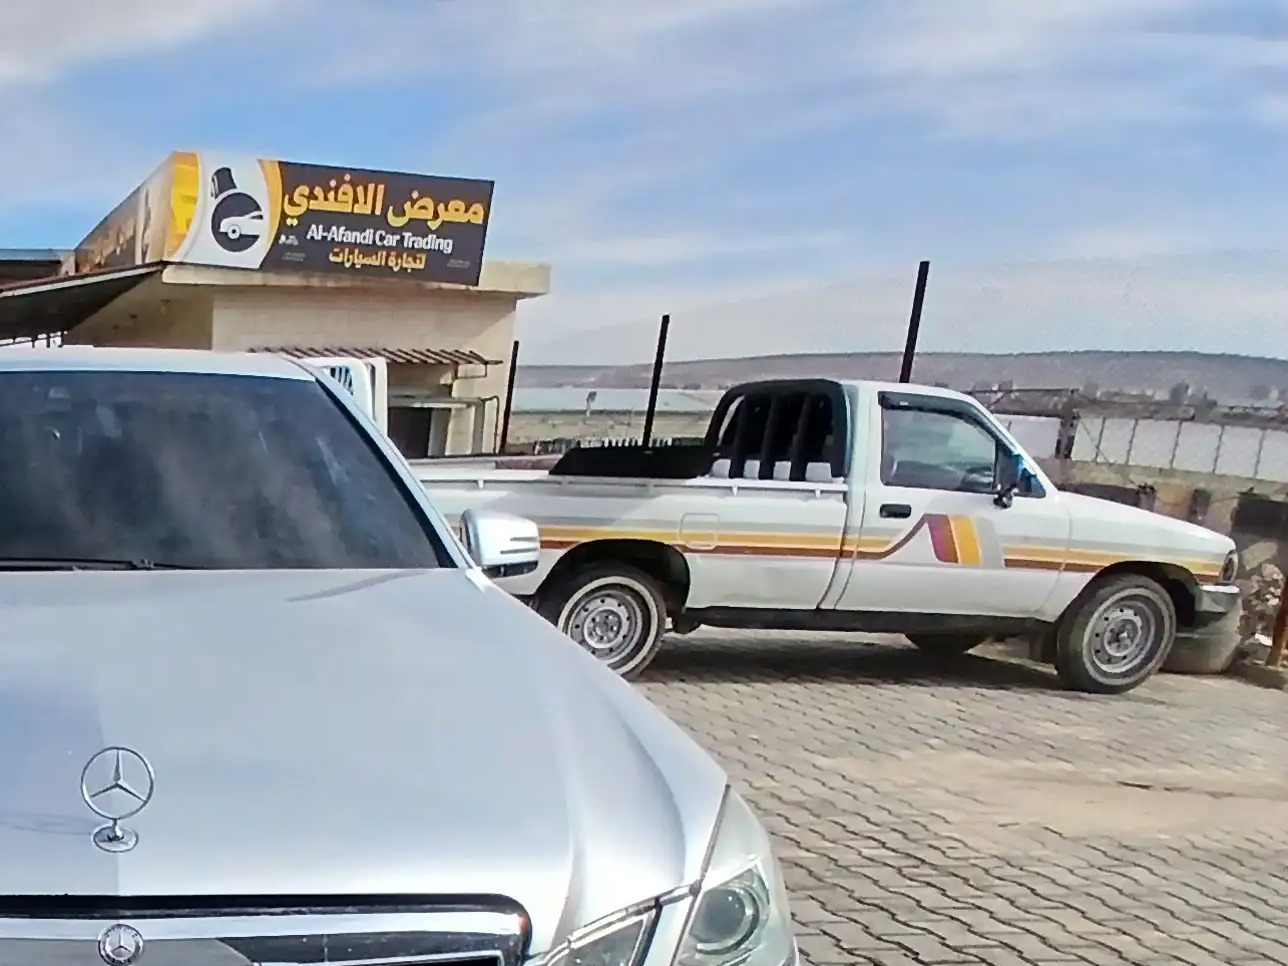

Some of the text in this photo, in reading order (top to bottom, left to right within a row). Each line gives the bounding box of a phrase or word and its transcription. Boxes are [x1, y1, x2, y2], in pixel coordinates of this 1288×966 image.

[283, 173, 485, 230] معرض الافندي
[307, 224, 374, 245] Al-Afandi
[375, 230, 400, 247] Car
[402, 232, 453, 254] Trading
[328, 248, 387, 269] السيارات
